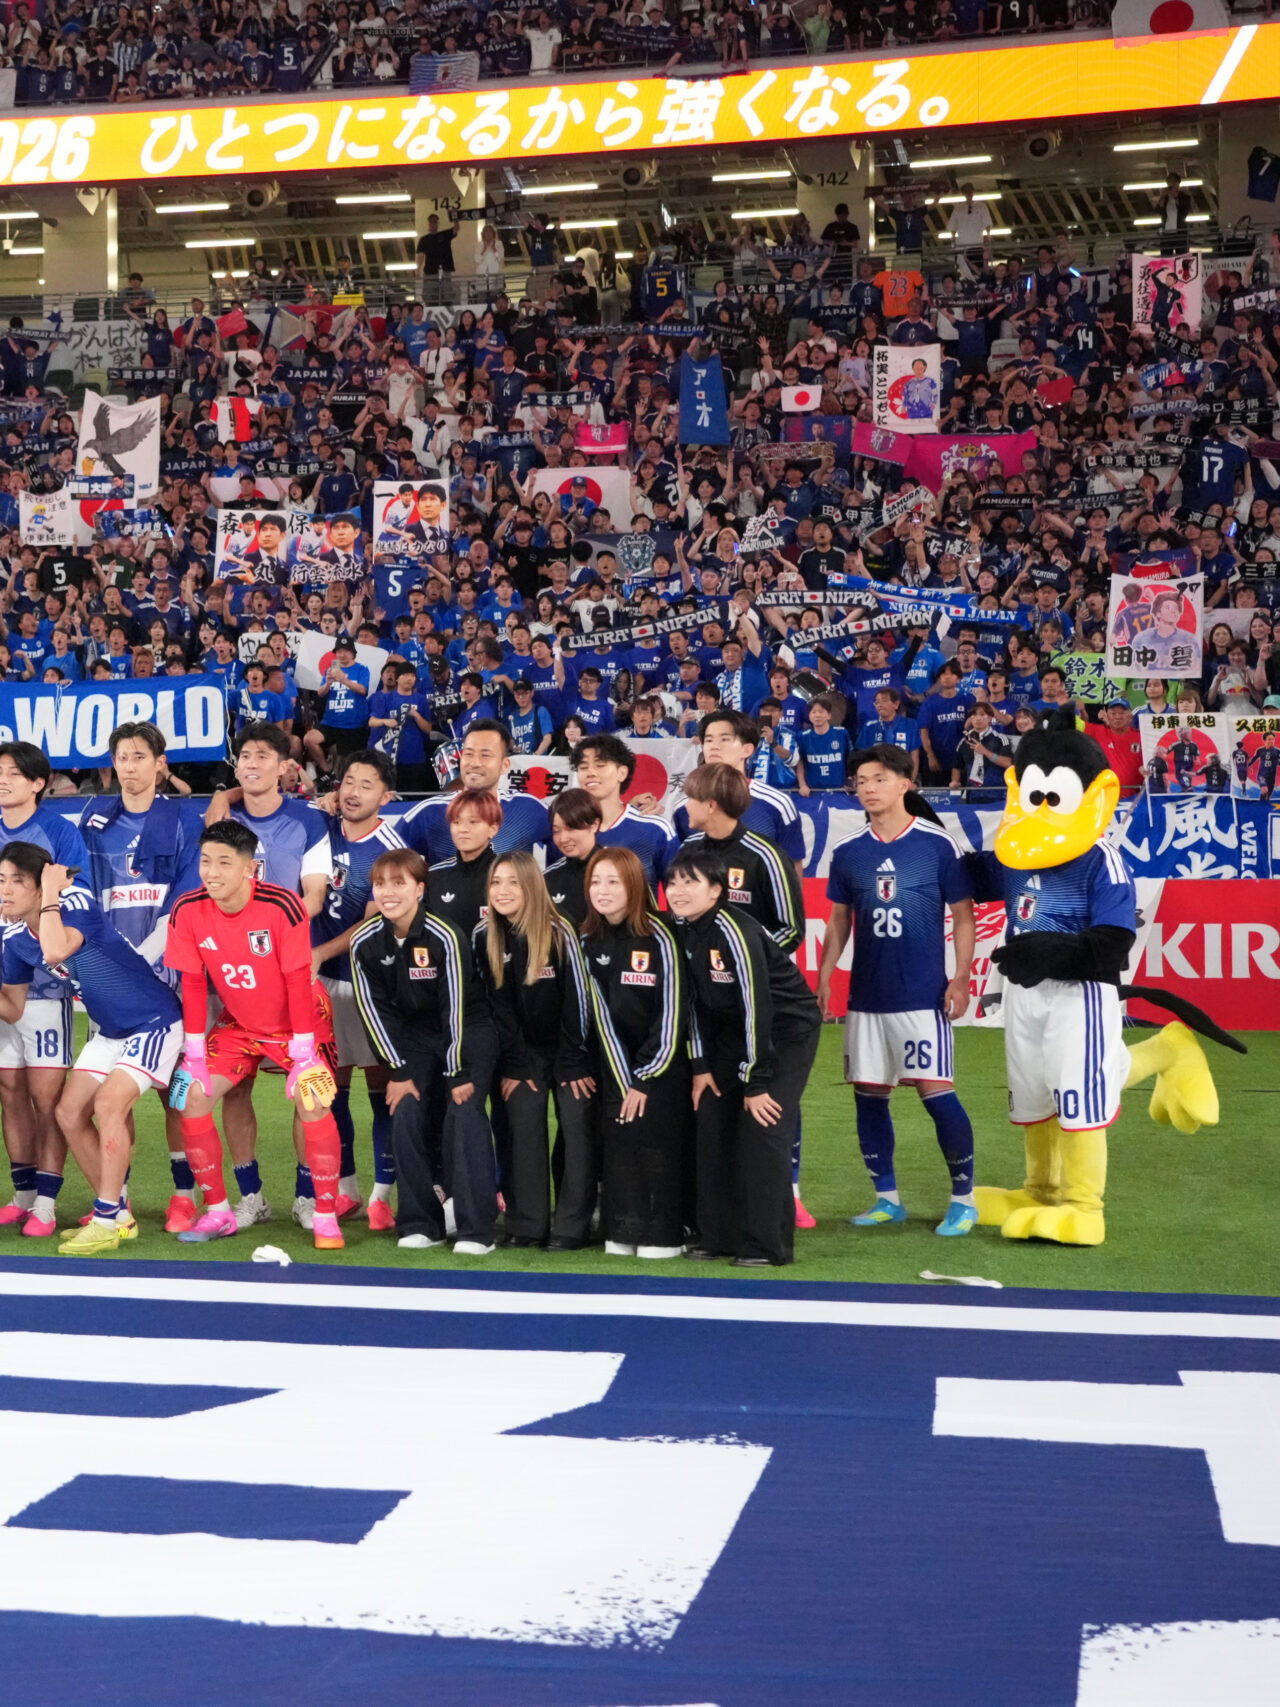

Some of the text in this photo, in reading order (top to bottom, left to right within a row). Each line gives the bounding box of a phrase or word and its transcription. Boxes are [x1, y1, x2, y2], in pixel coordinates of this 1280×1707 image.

[283, 47, 294, 66] 5
[483, 40, 517, 53] JAPAN
[140, 60, 950, 175] ひとつになるから強くなる。
[1259, 156, 1272, 177] 7
[817, 171, 849, 187] 142
[431, 196, 462, 211] 143
[656, 278, 668, 297] 5
[889, 277, 909, 297] 23
[820, 306, 857, 316] JAPAN
[11, 328, 49, 339] SAMURAI
[1077, 329, 1094, 350] 14
[287, 369, 328, 379] JAPAN
[875, 350, 889, 426] 拓実とともに
[1132, 403, 1165, 415] DOAN
[1199, 402, 1224, 413] 谷口
[165, 459, 207, 472] JAPAN
[1134, 453, 1162, 466] 純也
[1202, 455, 1224, 484] 17
[979, 496, 1021, 505] SAMURAI
[888, 503, 910, 522] BLUE
[219, 512, 242, 535] 森
[288, 513, 311, 535] 保
[23, 533, 67, 545] 伊東純也
[52, 562, 67, 585] 5
[229, 563, 275, 584] 一丸
[291, 563, 365, 584] 行雲流水
[656, 604, 720, 637] NIPPON
[872, 610, 934, 632] NIPPON
[967, 609, 1018, 621] JAPAN
[1113, 644, 1157, 668] 田中
[1064, 657, 1105, 678] 鈴木
[328, 690, 354, 711] IT BLUE
[14, 684, 225, 758] WORLD
[1151, 715, 1216, 728] 伊東 純也
[806, 752, 843, 764] ULTRAS
[819, 765, 830, 777] 12
[507, 769, 569, 797] 堂安
[329, 892, 343, 920] 2
[726, 891, 752, 903] IRIN
[872, 907, 903, 939] 26
[1145, 922, 1280, 980] KIR
[222, 963, 257, 991] 23
[410, 968, 438, 980] KIRIN
[622, 971, 656, 985] KIRIN
[35, 1030, 59, 1057] 18
[903, 1039, 933, 1071] 26
